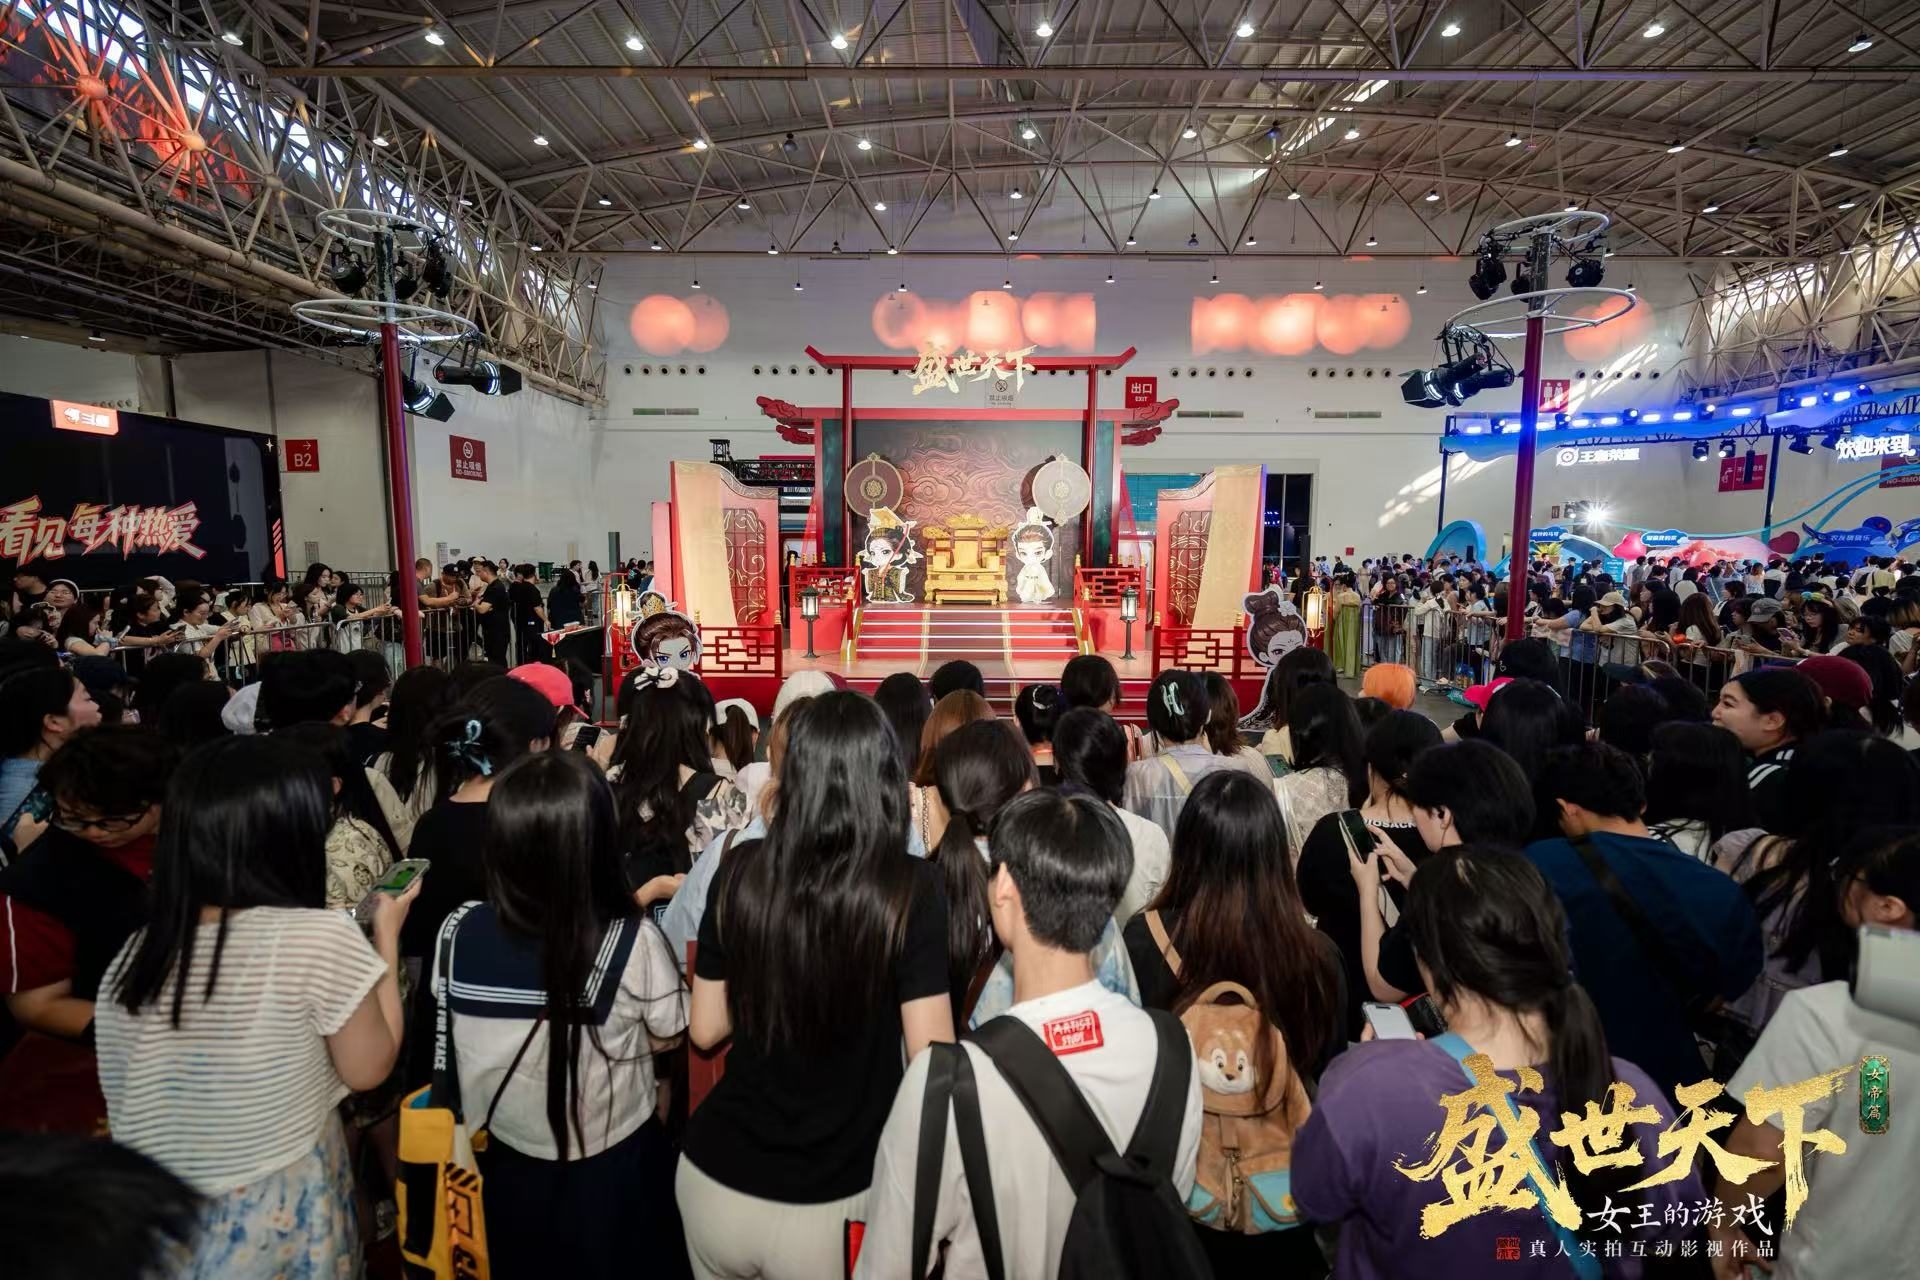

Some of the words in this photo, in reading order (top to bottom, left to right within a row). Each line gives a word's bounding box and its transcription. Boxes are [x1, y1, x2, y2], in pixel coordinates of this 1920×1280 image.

[906, 338, 1038, 396] 盛世天下
[1131, 383, 1152, 394] 出口
[294, 453, 312, 467] B2
[1835, 433, 1910, 461] 欢迎来到
[456, 459, 482, 471] 禁止吸烟
[0, 495, 207, 567] 看见每种热爱
[437, 977, 447, 1008] GAME
[436, 1009, 447, 1033] FOR
[434, 1033, 447, 1071] PEACE
